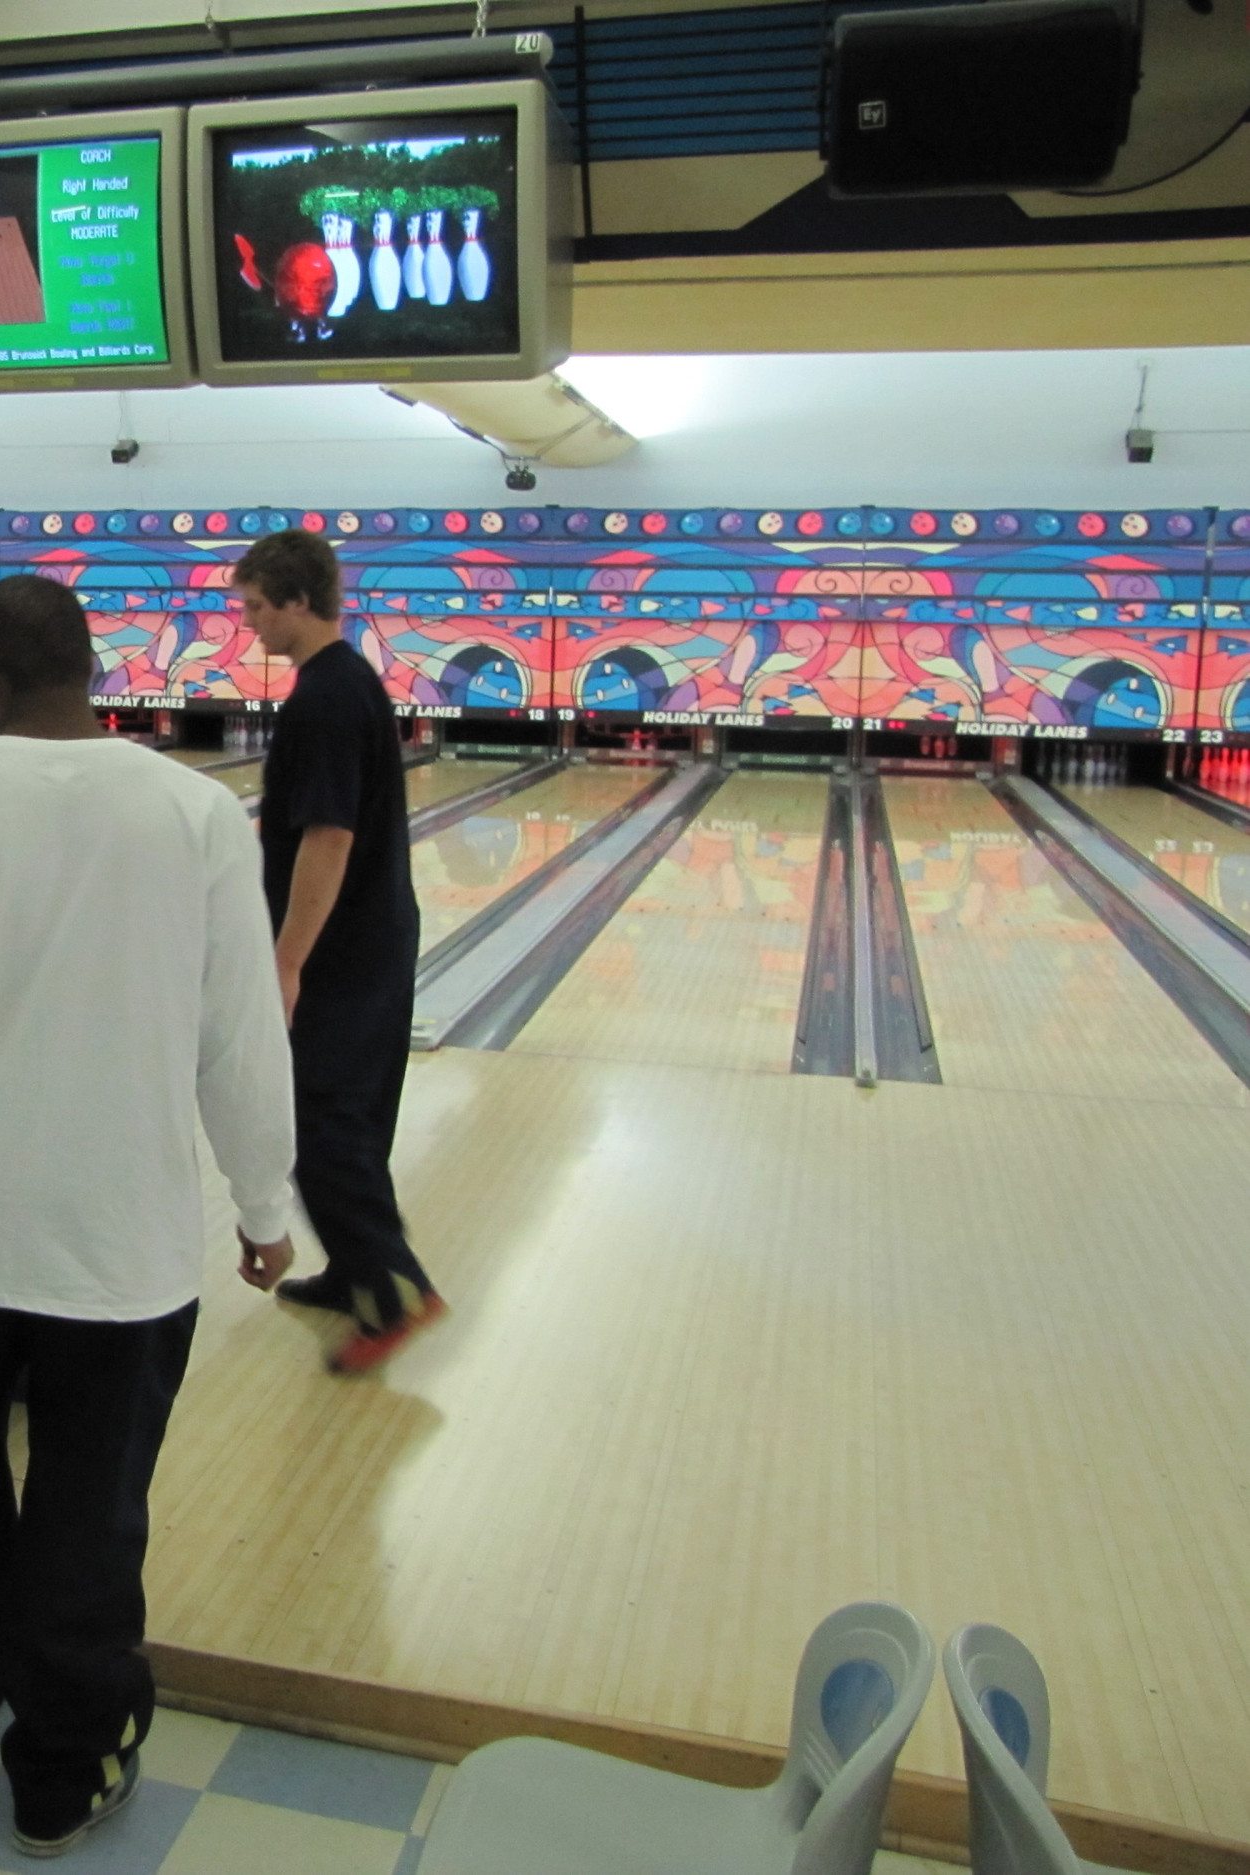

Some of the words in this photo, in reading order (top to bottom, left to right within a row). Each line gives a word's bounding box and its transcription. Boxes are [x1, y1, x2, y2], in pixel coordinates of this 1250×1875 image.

[516, 33, 539, 52] 20
[80, 149, 111, 163] COACH
[62, 179, 86, 195] Right
[92, 177, 128, 191] Handed
[81, 206, 91, 220] of
[97, 204, 139, 220] Difficulty
[71, 223, 118, 240] MODERATE
[11, 349, 47, 361] Brunswick
[50, 348, 78, 360] Bowling
[82, 347, 95, 358] and
[98, 345, 130, 357] Billiards
[143, 697, 185, 708] LANES
[245, 701, 260, 711] 16
[416, 706, 462, 718] LANES
[528, 709, 545, 720] 18
[557, 709, 575, 720] 19
[643, 711, 711, 724] HOLIDAY
[715, 713, 764, 726] LANES
[831, 717, 853, 729] 20
[863, 719, 881, 730] 21
[956, 722, 1029, 736] HOLIDAY
[1033, 725, 1087, 738] LANES
[1162, 729, 1185, 742] 22
[1200, 730, 1223, 743] 23
